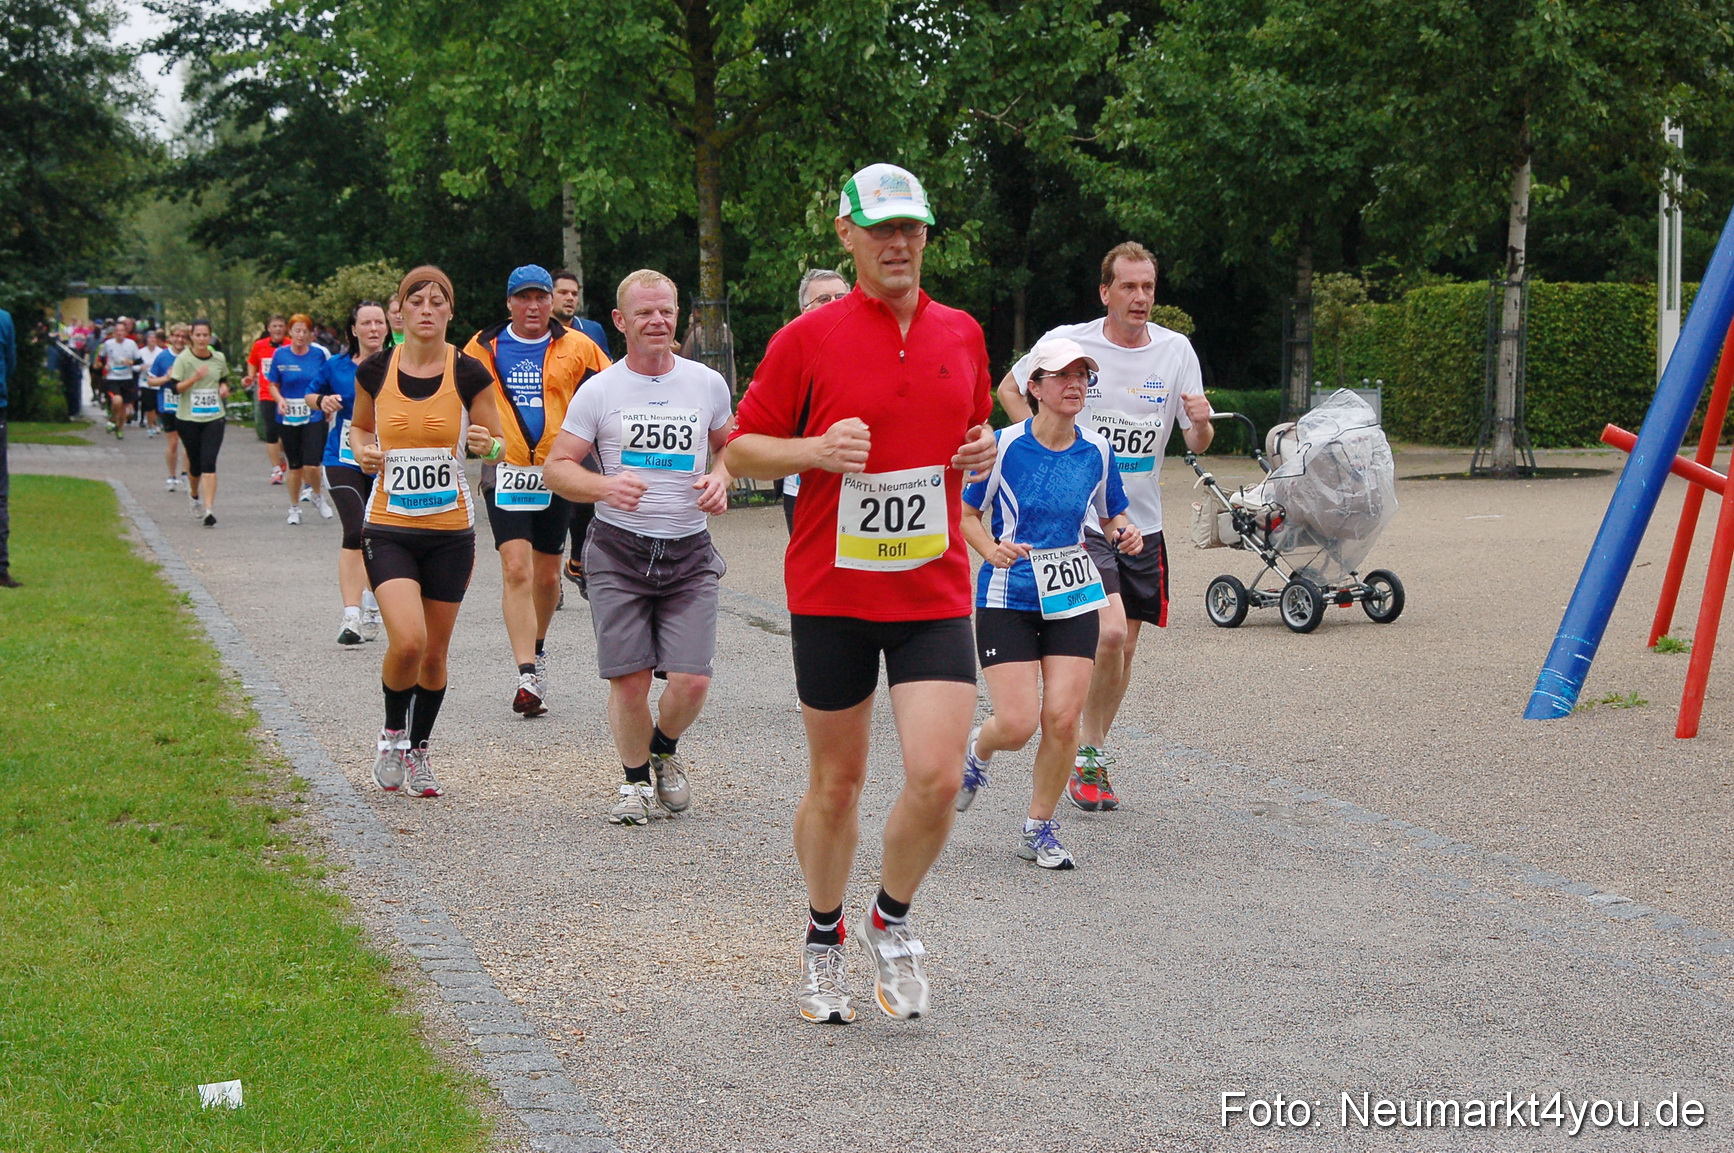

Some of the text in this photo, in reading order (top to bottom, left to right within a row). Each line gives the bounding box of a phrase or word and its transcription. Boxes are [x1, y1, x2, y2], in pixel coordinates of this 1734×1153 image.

[1092, 414, 1117, 424] PARTL
[629, 423, 693, 451] 2563
[386, 454, 445, 463] PARTL Neumarkt
[645, 455, 673, 467] Klaus
[1116, 461, 1139, 470] nest
[392, 464, 451, 491] 2066
[844, 477, 928, 492] PARTL Neumarkt
[401, 495, 443, 507] Theresia
[511, 495, 536, 503] Werner
[860, 494, 926, 533] 202
[878, 542, 907, 557] Rofl
[1032, 552, 1059, 562] PARTL
[1043, 554, 1093, 591] 2607
